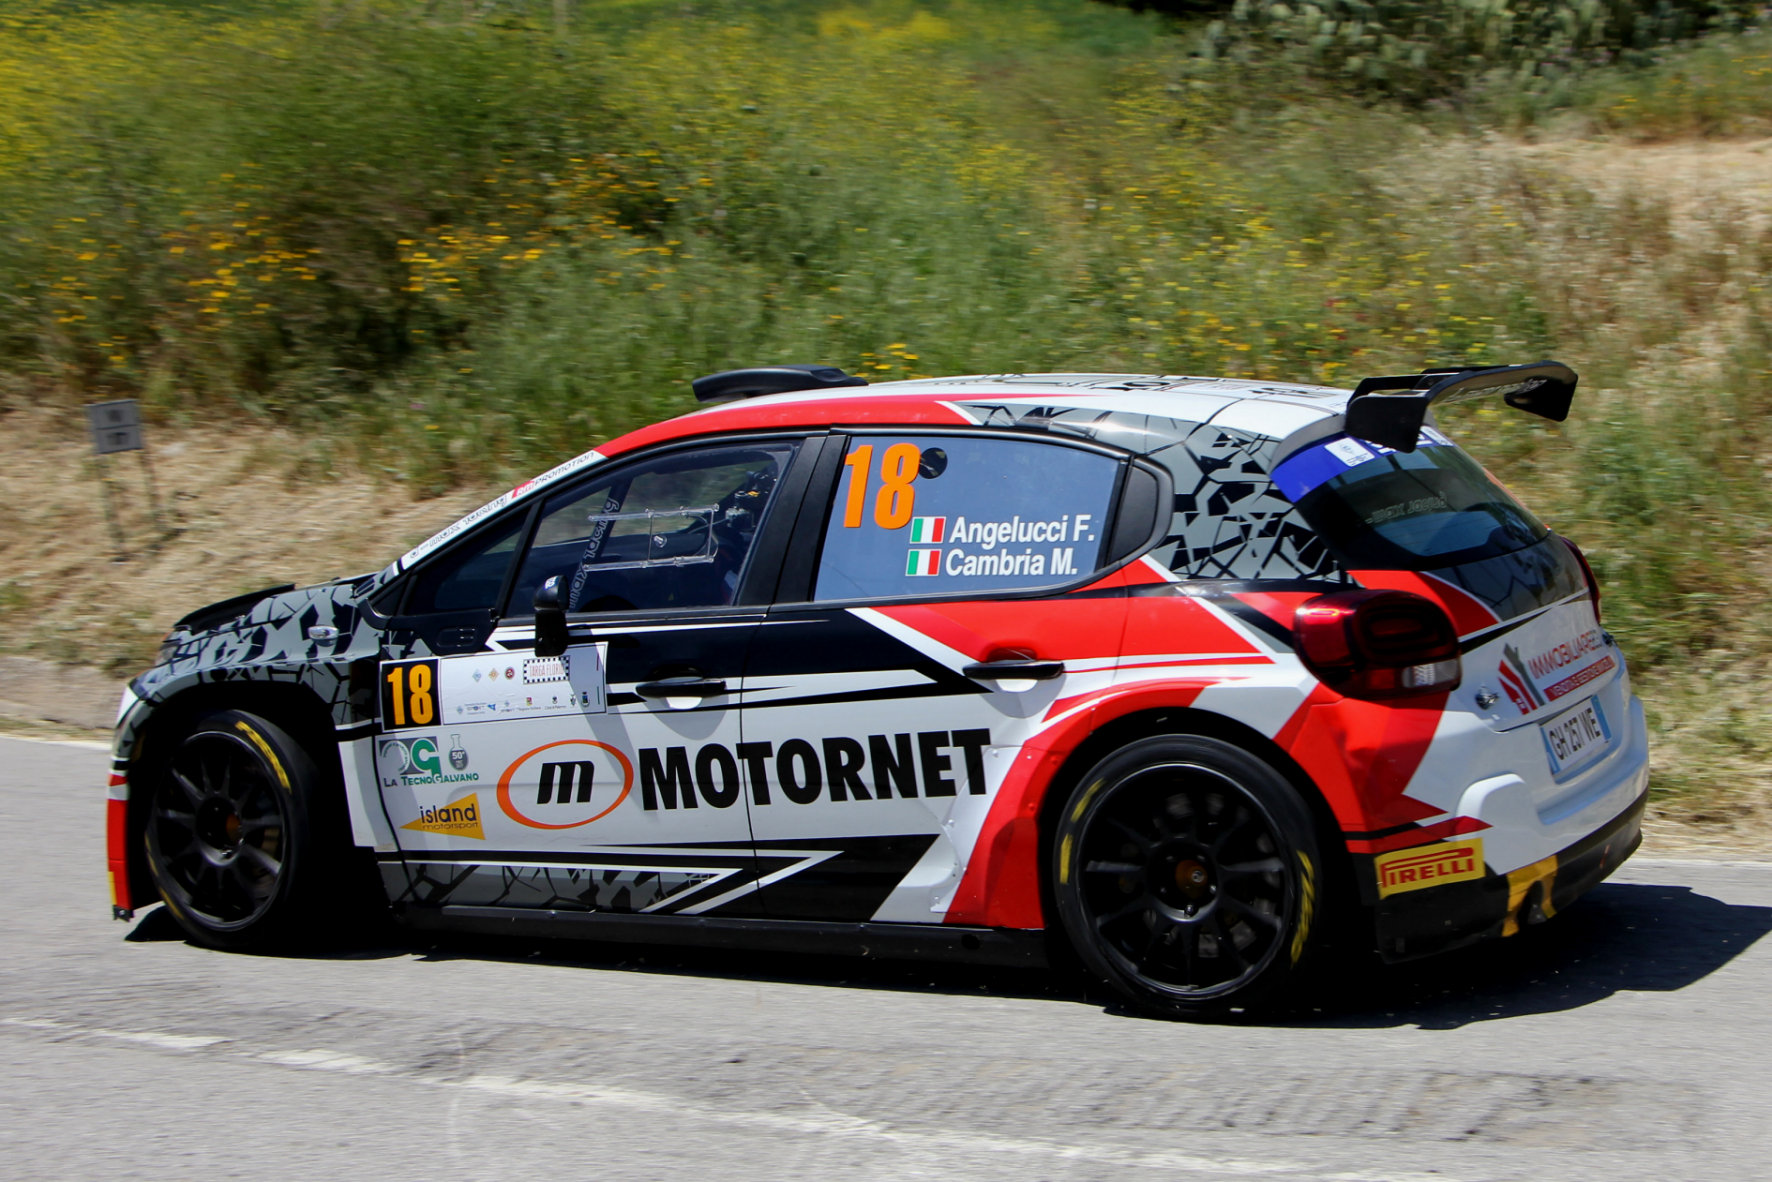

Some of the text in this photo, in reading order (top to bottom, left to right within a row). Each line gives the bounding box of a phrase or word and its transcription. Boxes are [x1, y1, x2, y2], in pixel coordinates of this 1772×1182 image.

[842, 442, 922, 530] 18
[948, 513, 1095, 549] Angelucci F.
[945, 548, 1078, 577] Cambria M.
[386, 664, 433, 726] 18
[638, 728, 992, 812] MOTORNET
[419, 802, 477, 824] island
[422, 822, 479, 830] motorsport
[1379, 846, 1474, 888] PIRELLI
